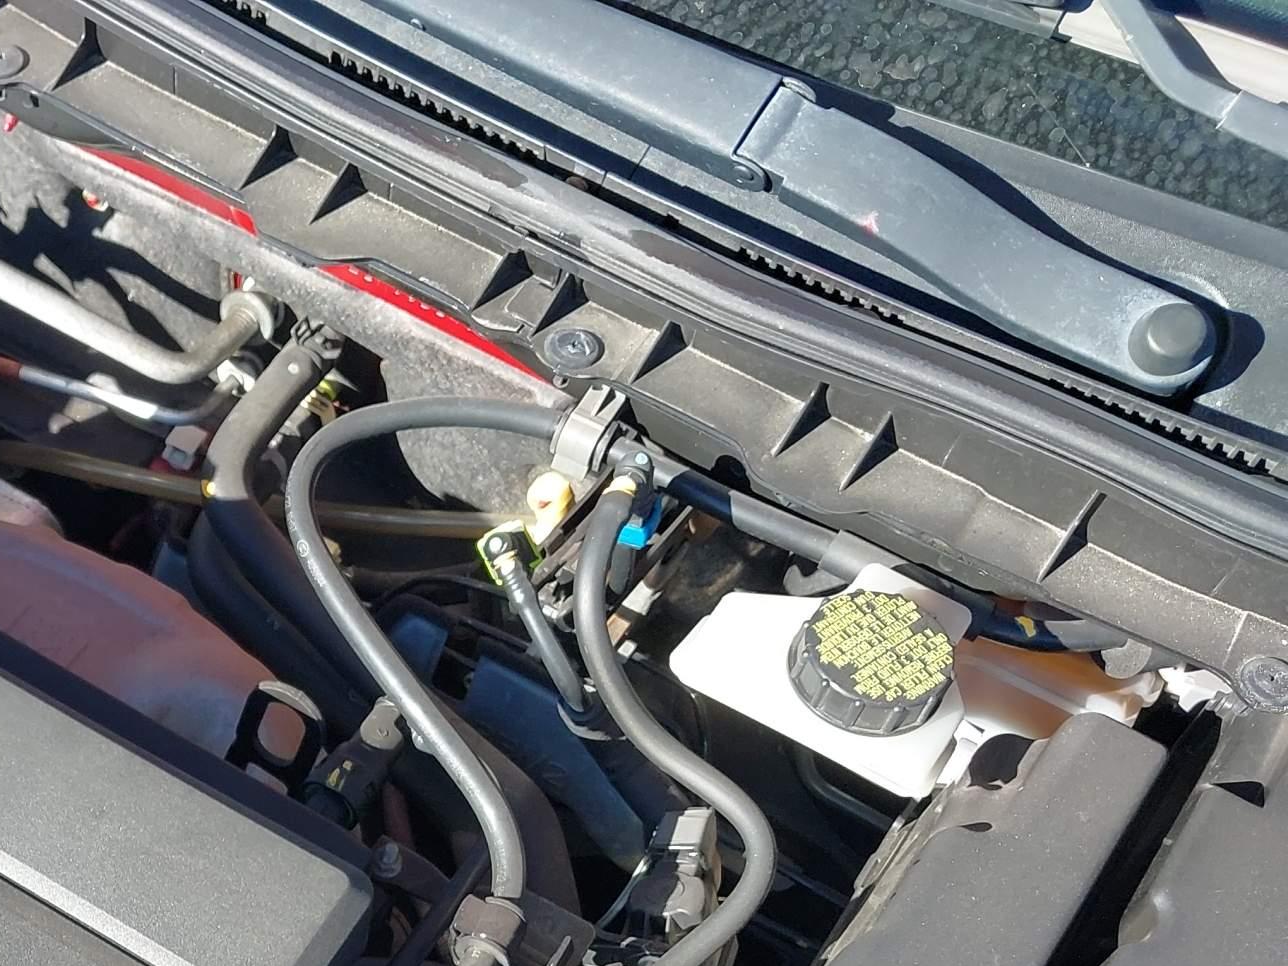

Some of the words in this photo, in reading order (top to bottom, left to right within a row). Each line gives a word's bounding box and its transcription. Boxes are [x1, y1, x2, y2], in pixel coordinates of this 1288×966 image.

[862, 602, 874, 613] 3
[873, 594, 889, 607] DOT
[874, 597, 906, 617] PLOYER
[893, 600, 918, 619] AVANT
[812, 602, 857, 633] CONTENANT
[817, 609, 864, 640] PROVENANT
[857, 613, 877, 627] QUE
[881, 613, 896, 627] DE
[881, 610, 922, 638] NETTOYER
[846, 623, 859, 636] DU
[870, 621, 885, 633] LE
[924, 628, 935, 637] A
[867, 634, 881, 647] LE
[896, 633, 927, 656] SEALED
[927, 632, 948, 650] ONLY
[833, 641, 872, 670] BOUCHON
[900, 655, 911, 663] 3
[911, 645, 927, 659] DOT
[922, 643, 953, 664] BEFORE
[877, 661, 901, 679] FLUID
[927, 654, 953, 674] CLEAN
[854, 676, 881, 695] FROM
[901, 670, 930, 690] FILLER
[904, 672, 946, 700] WARNING:
[867, 683, 886, 699] USE
[885, 687, 902, 701] CAP
